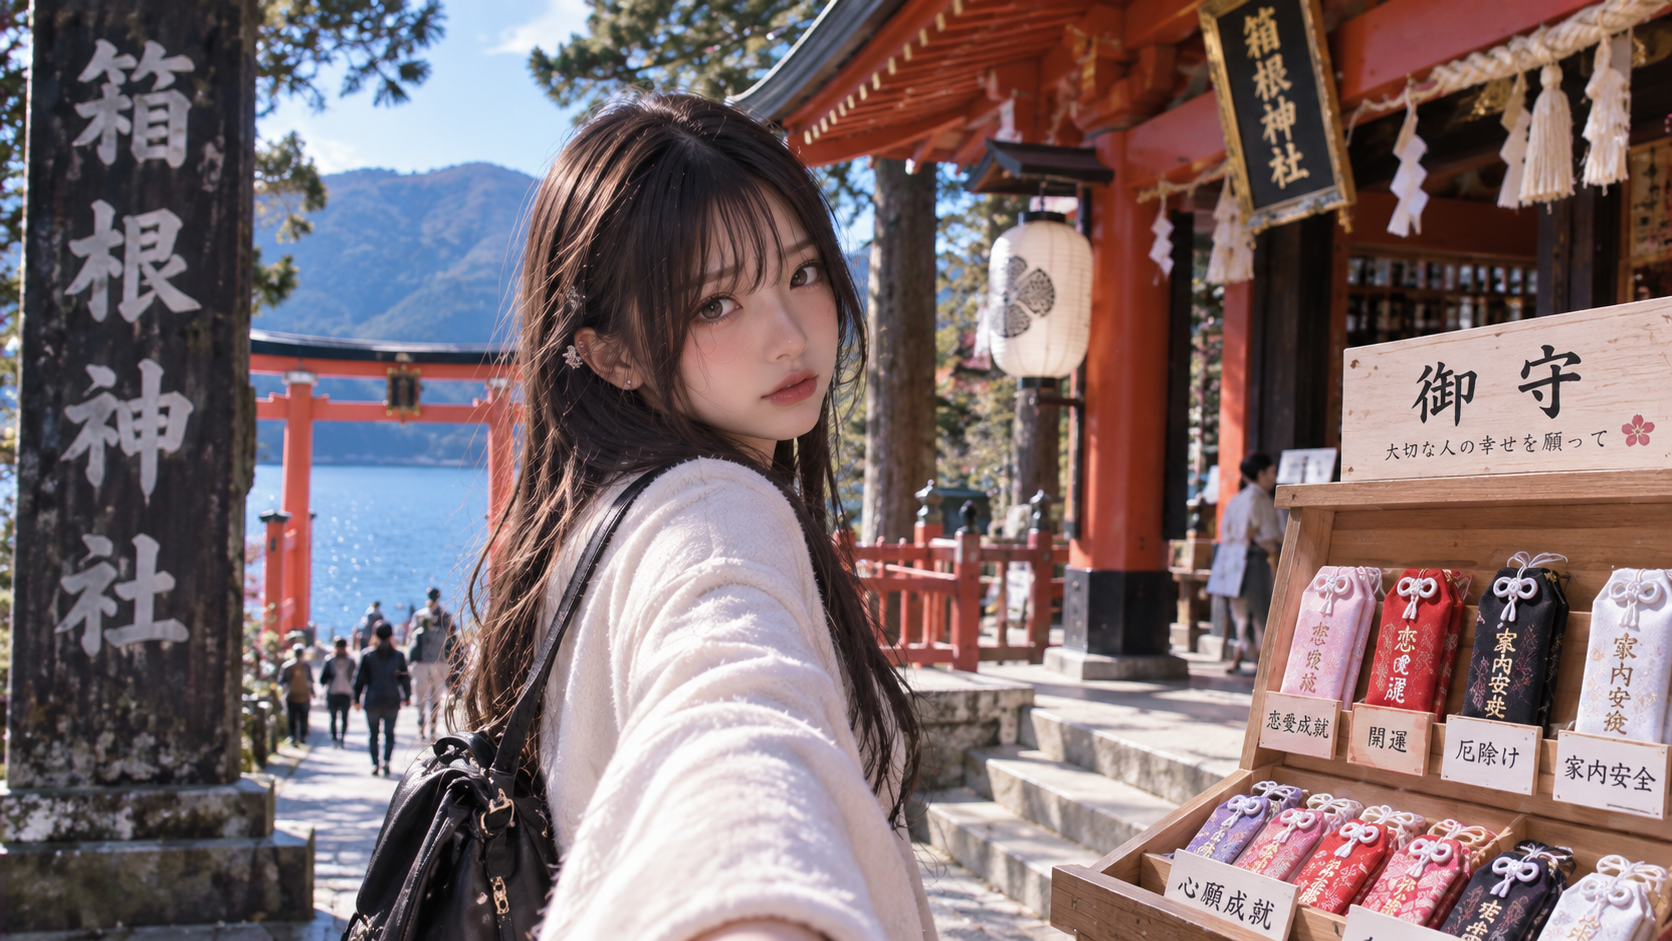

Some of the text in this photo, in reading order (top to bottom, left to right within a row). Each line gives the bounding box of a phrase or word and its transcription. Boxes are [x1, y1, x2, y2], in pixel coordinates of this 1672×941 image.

[1243, 6, 1309, 190] 箱根神社
[55, 38, 201, 657] 箱根神社
[1412, 345, 1582, 427] 御守
[1385, 430, 1607, 462] 大切な人の幸せを願って
[1266, 710, 1330, 739] 恋愛成就
[1368, 726, 1408, 753] 開運
[1455, 739, 1520, 769] 厄除け
[1564, 755, 1656, 793] 家内安全
[1177, 876, 1275, 931] 心願成就
